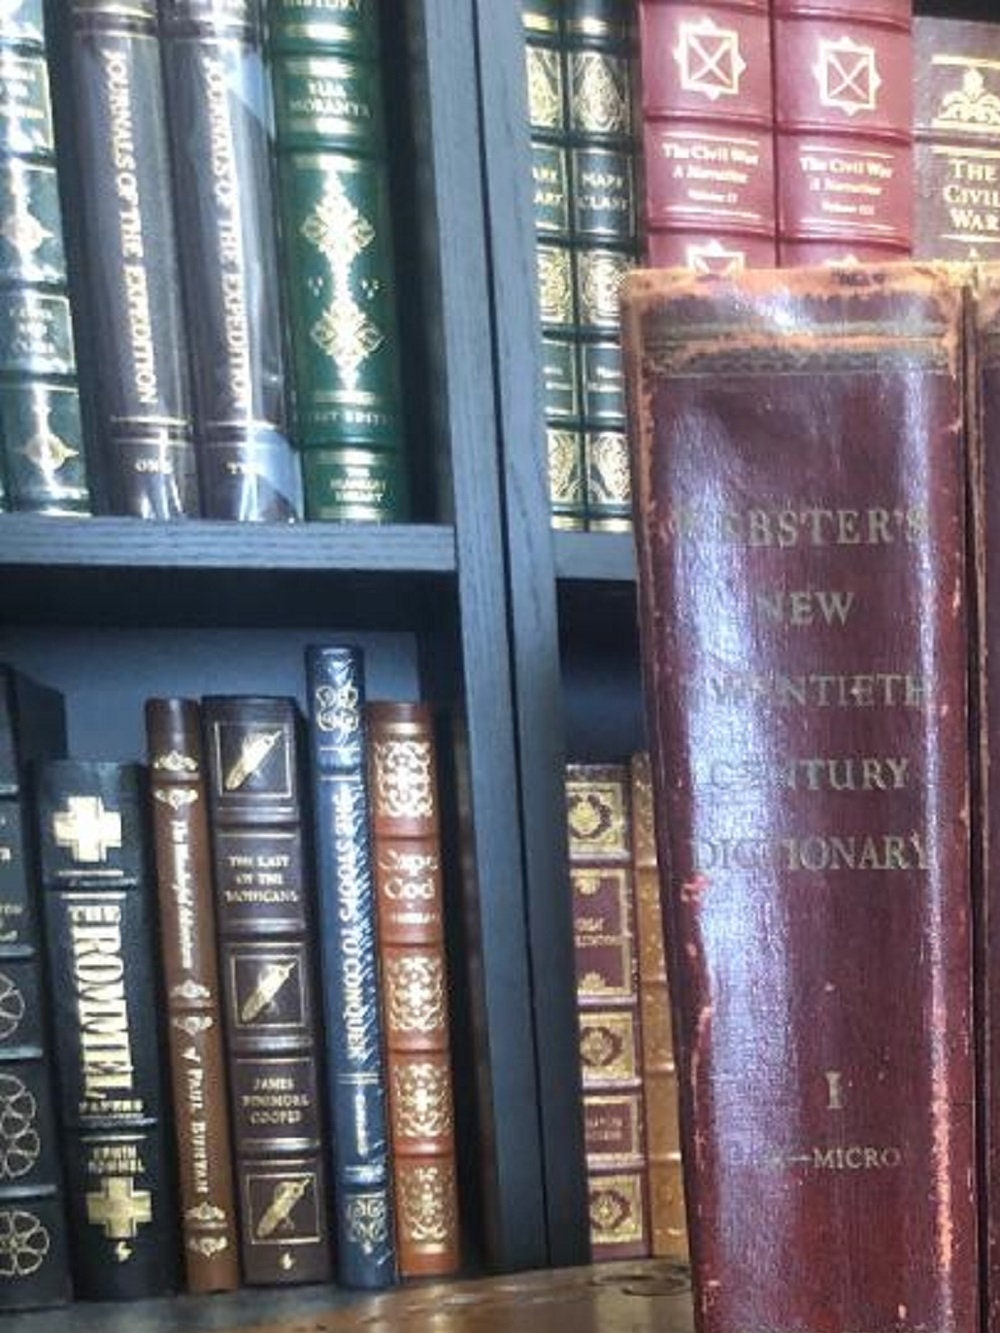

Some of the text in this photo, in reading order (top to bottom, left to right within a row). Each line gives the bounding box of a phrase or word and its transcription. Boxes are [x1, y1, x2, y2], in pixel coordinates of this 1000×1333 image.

[949, 158, 998, 182] THE
[120, 208, 143, 258] THE
[950, 206, 1000, 231] WAR
[674, 507, 930, 547] EBSTER'S
[755, 591, 856, 627] NEW
[686, 673, 931, 709] ENTIETH
[711, 756, 909, 792] NTURY
[69, 924, 135, 1099] ROMMEL
[824, 1071, 843, 1110] I
